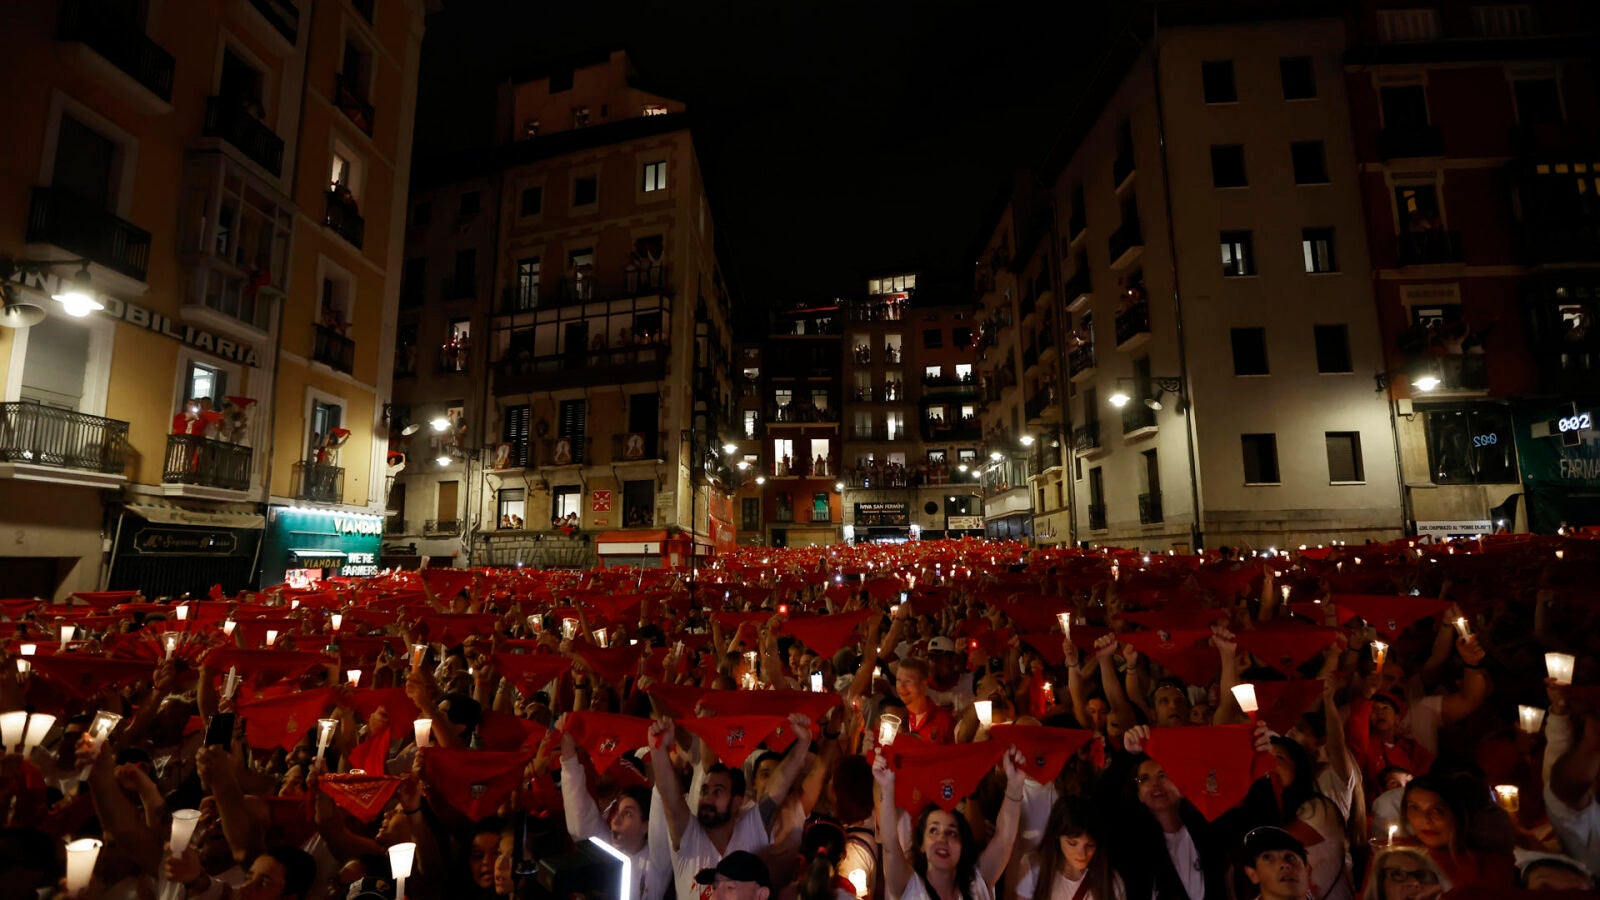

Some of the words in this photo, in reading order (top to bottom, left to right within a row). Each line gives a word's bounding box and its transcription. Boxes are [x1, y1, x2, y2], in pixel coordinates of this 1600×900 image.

[9, 268, 260, 367] INOBILIARIA
[1558, 414, 1590, 432] 0:02
[333, 518, 382, 535] VIANDAS
[303, 558, 341, 569] VIANDAS
[348, 552, 374, 564] WE'RE
[341, 565, 378, 576] FARMERS
